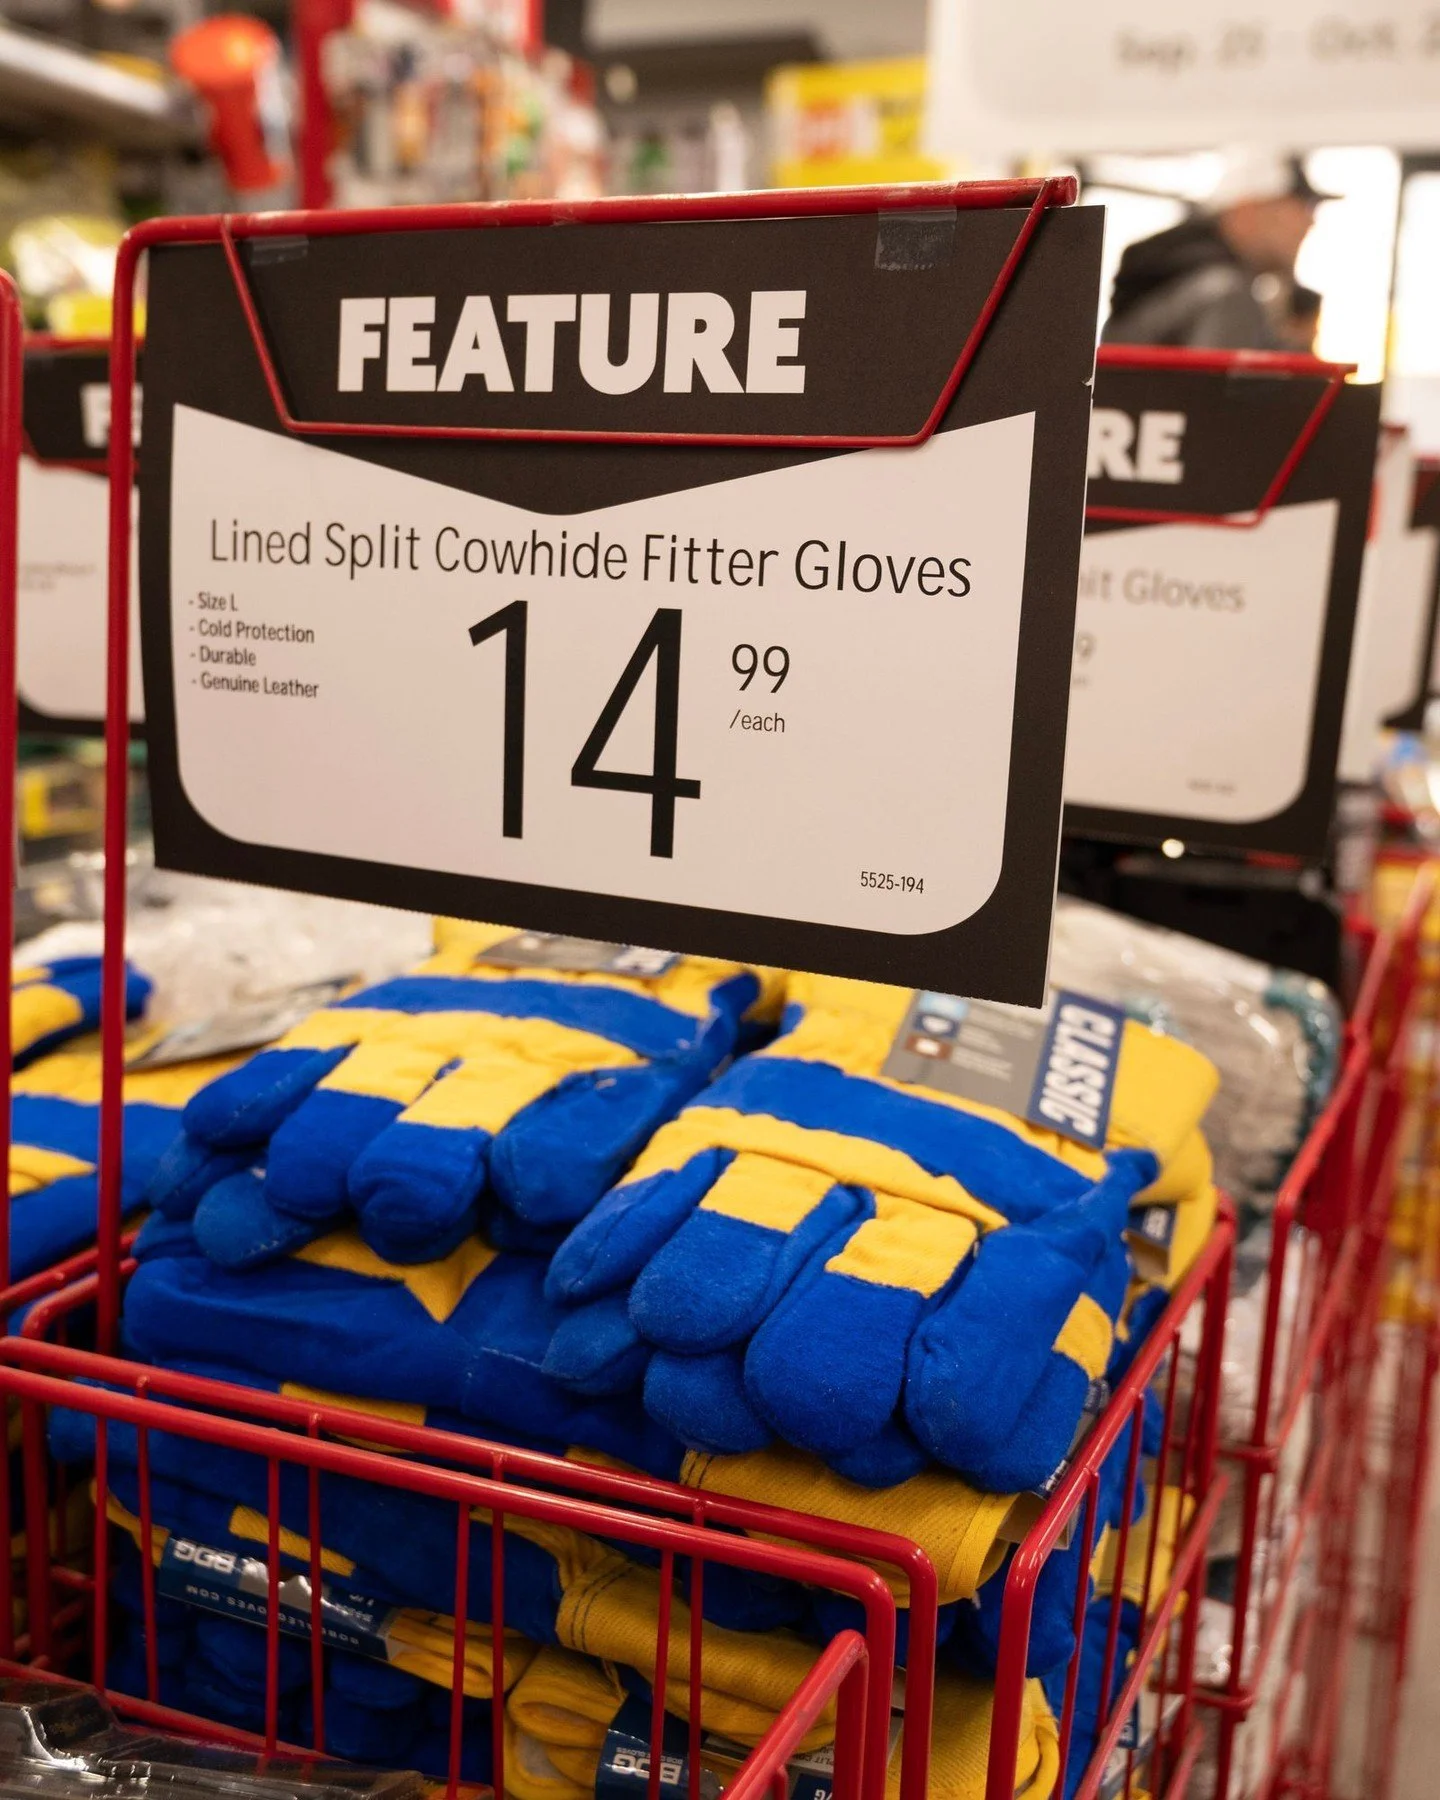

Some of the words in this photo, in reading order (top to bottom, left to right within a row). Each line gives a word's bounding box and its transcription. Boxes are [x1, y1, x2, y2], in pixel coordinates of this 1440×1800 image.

[338, 290, 807, 395] FEATURE
[211, 519, 311, 565] Lined
[325, 522, 420, 580] Split
[435, 526, 628, 581] Cowhide
[643, 533, 779, 588] Fitter
[795, 539, 972, 598] Gloves
[198, 591, 227, 611] Size
[230, 592, 239, 612] L
[1121, 567, 1246, 614] Gloves
[199, 618, 232, 638] Cold
[236, 620, 315, 643] Protection
[199, 644, 257, 667] Durable
[201, 671, 260, 693] Genuine
[263, 676, 319, 699] Leather
[468, 599, 701, 859] 14
[731, 643, 791, 694] 99
[729, 708, 786, 734] /each
[860, 870, 925, 894] 5525-194
[1038, 1003, 1116, 1137] CLASSIC
[173, 1539, 238, 1574] BDG
